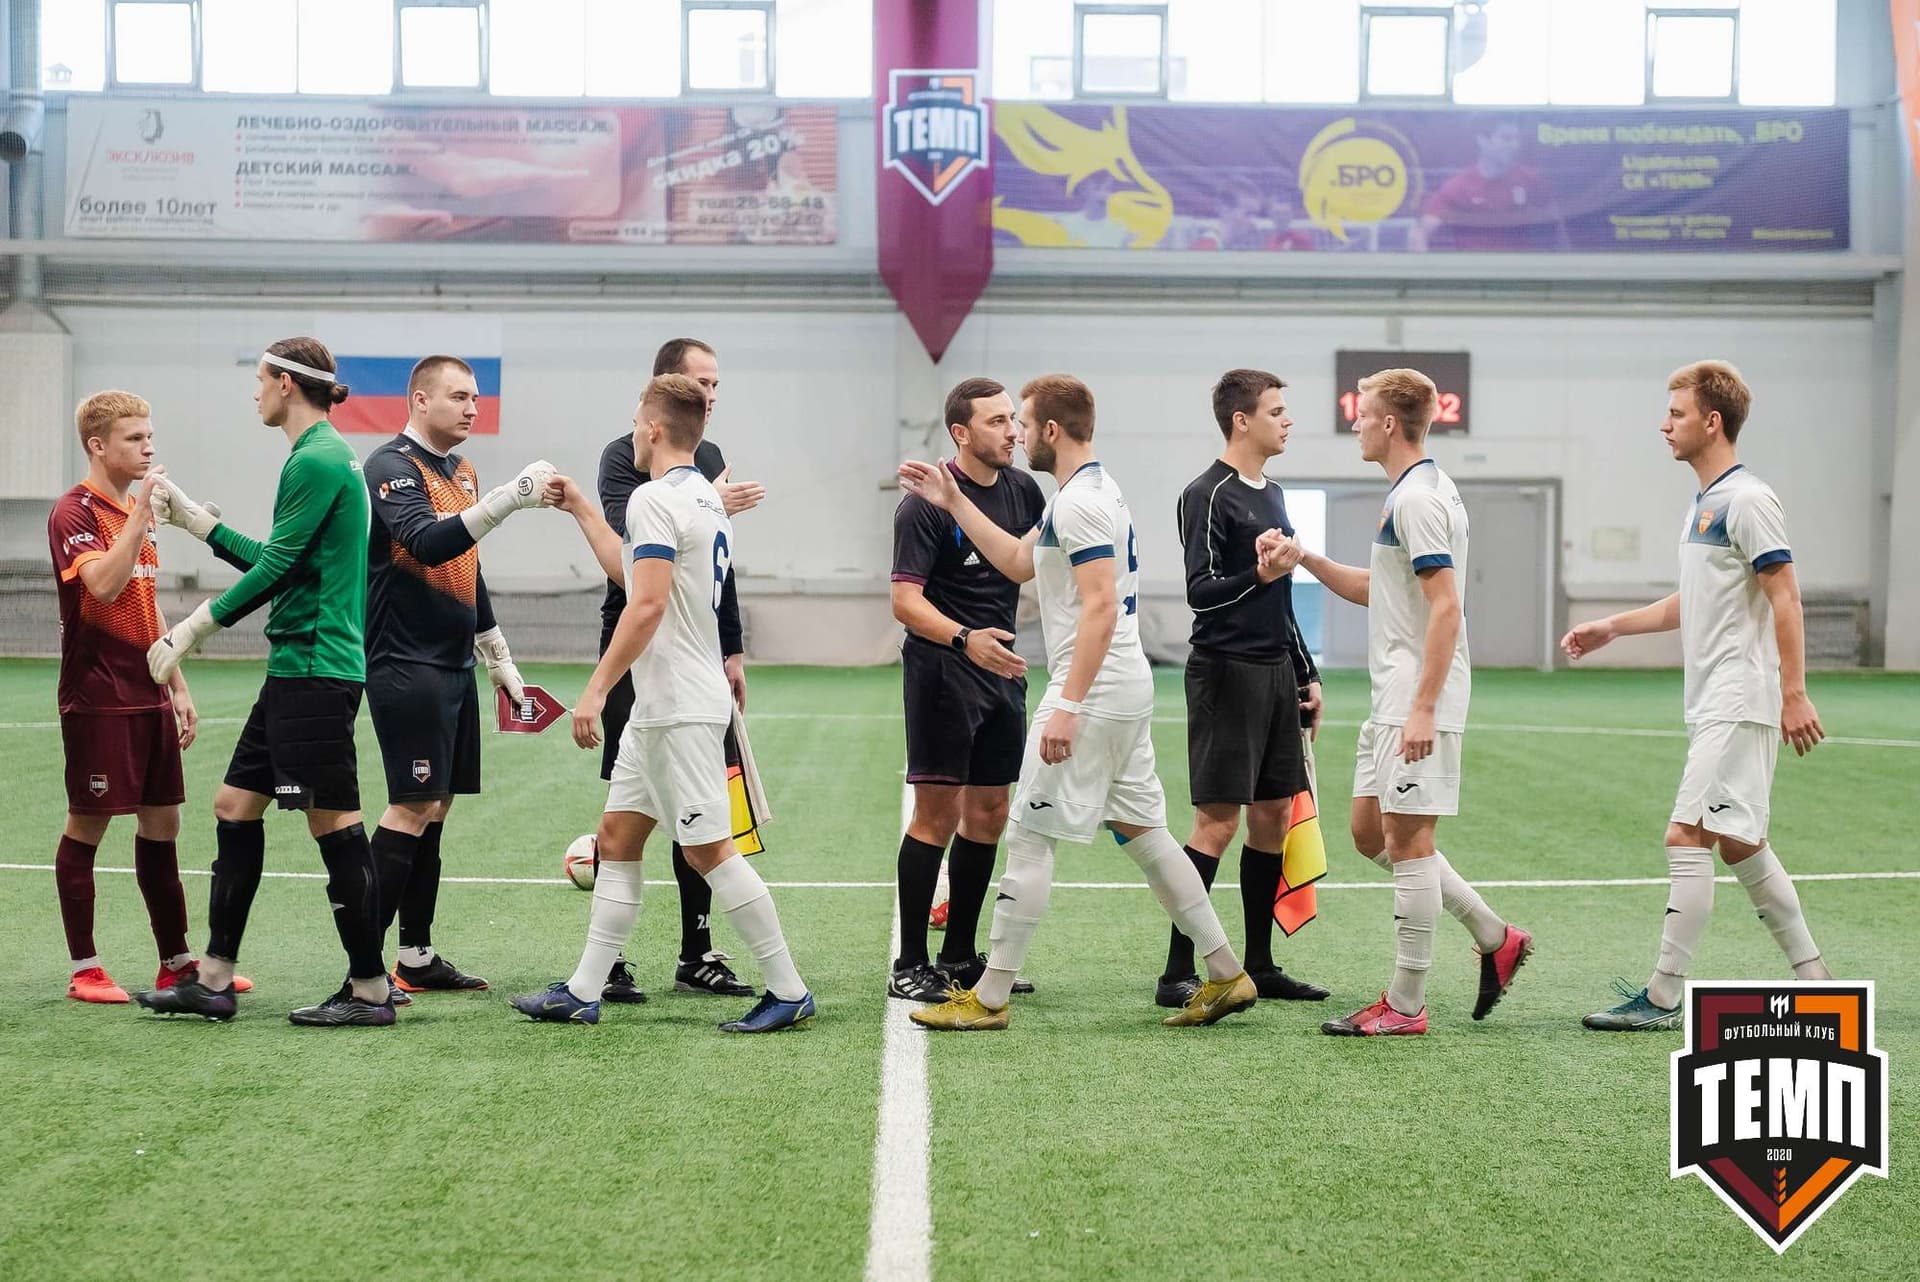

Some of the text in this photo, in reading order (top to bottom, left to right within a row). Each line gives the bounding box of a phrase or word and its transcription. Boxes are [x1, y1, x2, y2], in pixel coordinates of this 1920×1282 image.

[893, 107, 978, 153] ТЕМП
[236, 160, 323, 177] ДЕТСКИЙ
[79, 195, 147, 217] более
